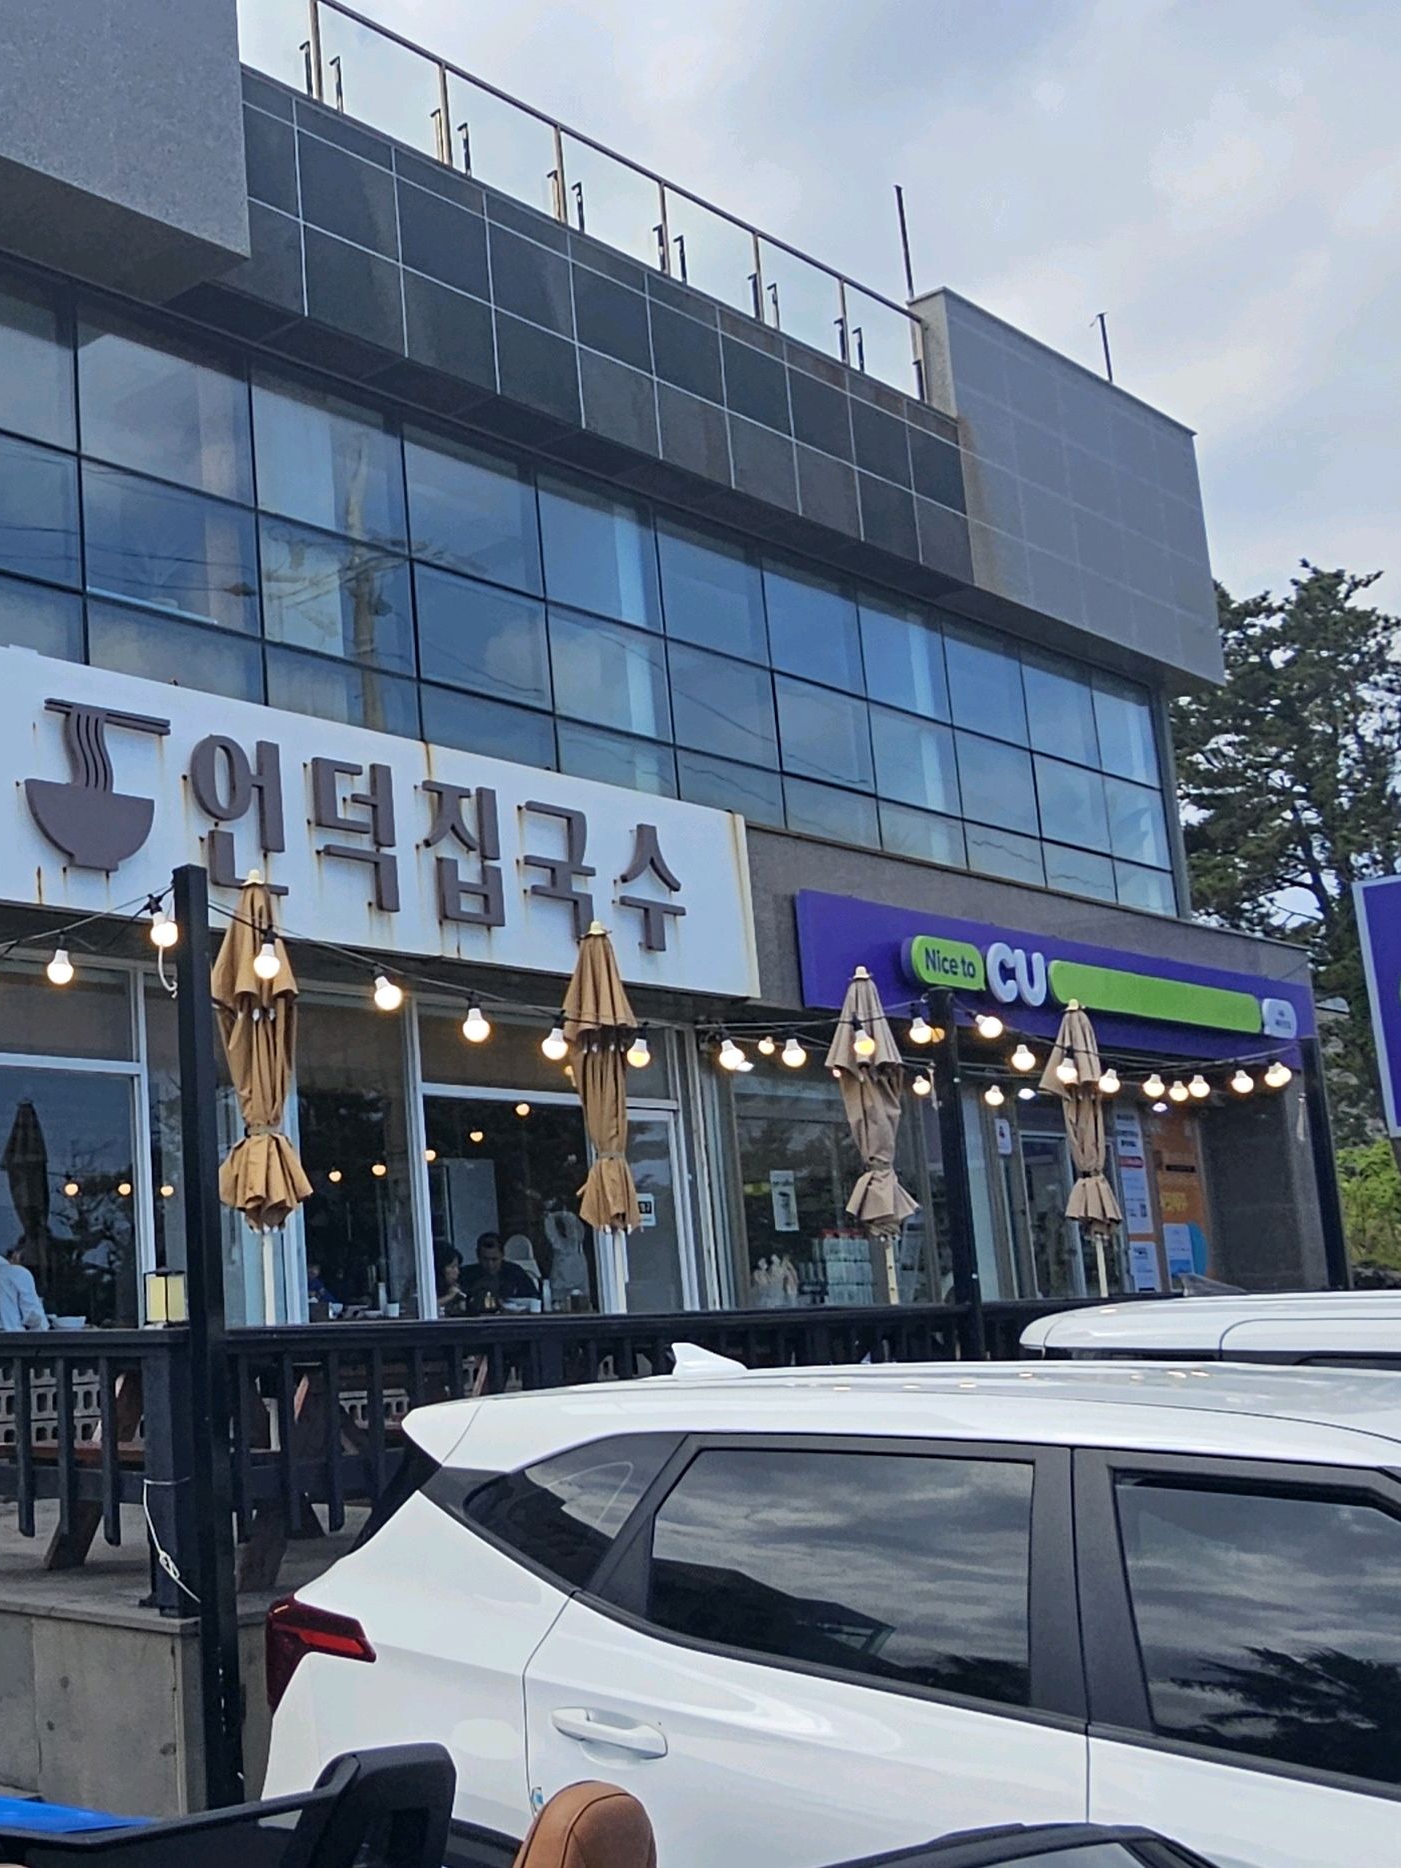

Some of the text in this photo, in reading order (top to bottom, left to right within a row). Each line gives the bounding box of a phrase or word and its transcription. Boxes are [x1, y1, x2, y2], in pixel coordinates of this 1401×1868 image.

[191, 734, 686, 952] 언덕집국수
[925, 942, 1047, 1007] Nice to CU
